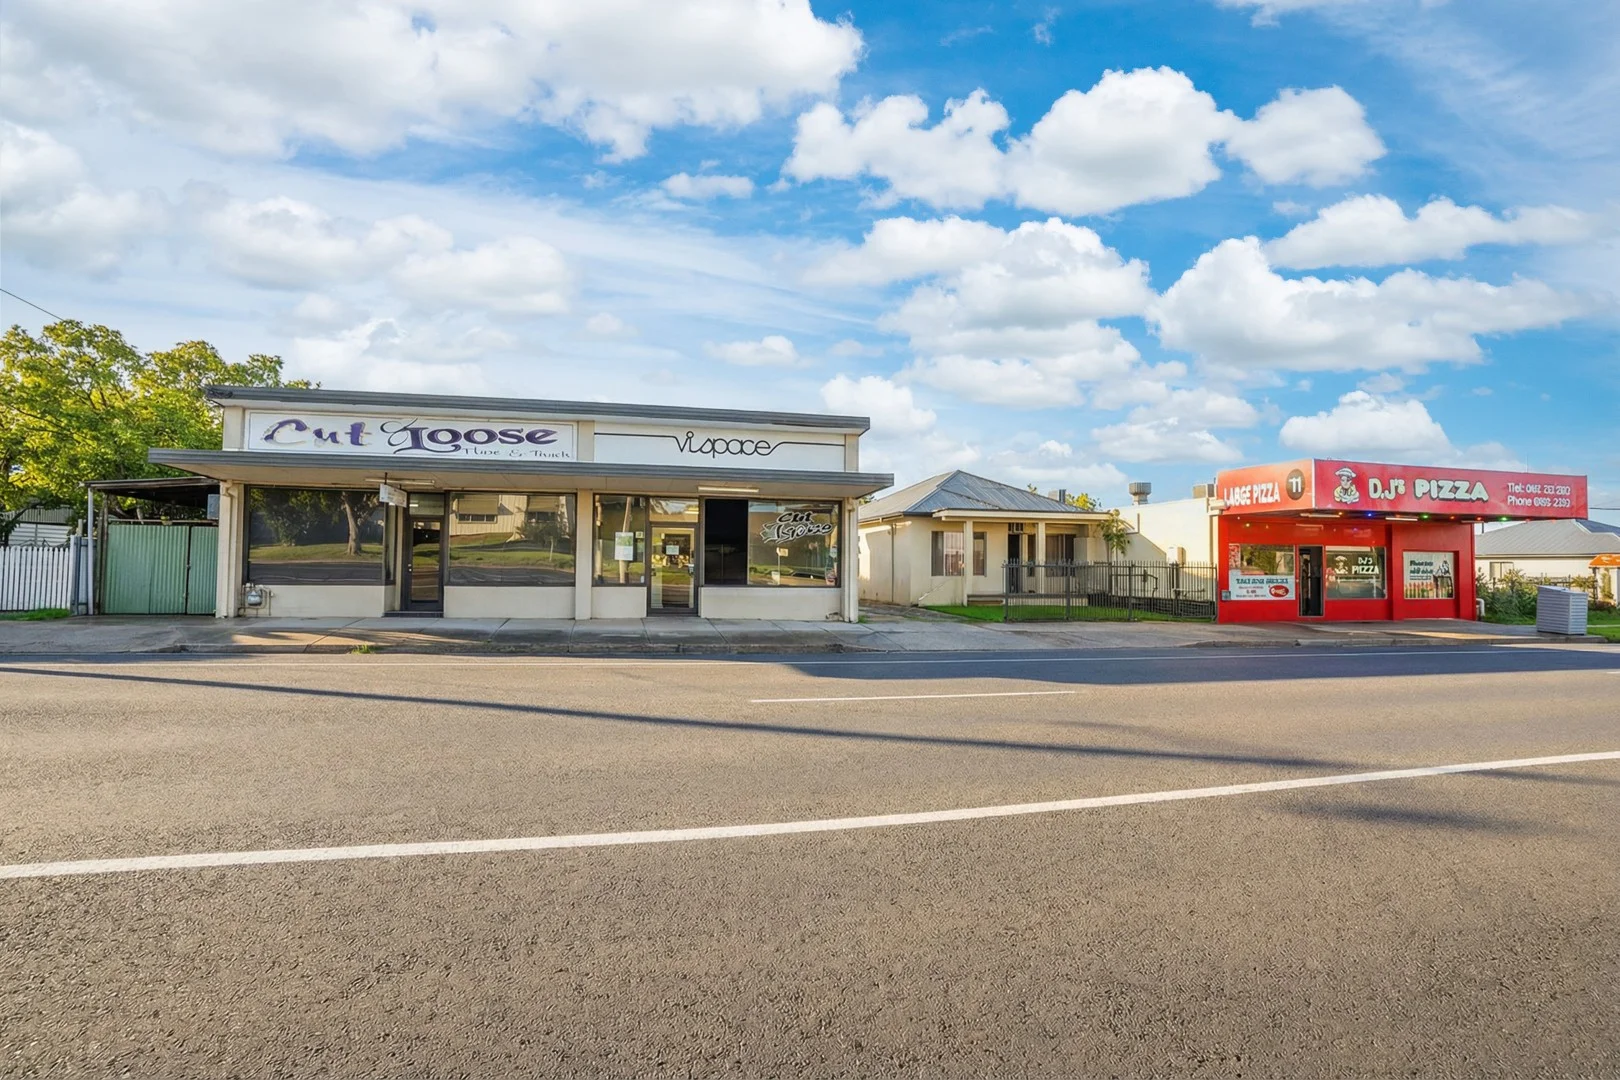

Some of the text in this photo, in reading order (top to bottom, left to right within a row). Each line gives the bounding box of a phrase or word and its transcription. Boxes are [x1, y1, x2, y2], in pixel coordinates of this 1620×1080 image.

[261, 418, 558, 455] Cut Loose
[675, 430, 774, 459] vispace
[1252, 481, 1280, 504] PIZZA
[1414, 478, 1489, 502] PIZZA
[1507, 495, 1532, 506] Phone
